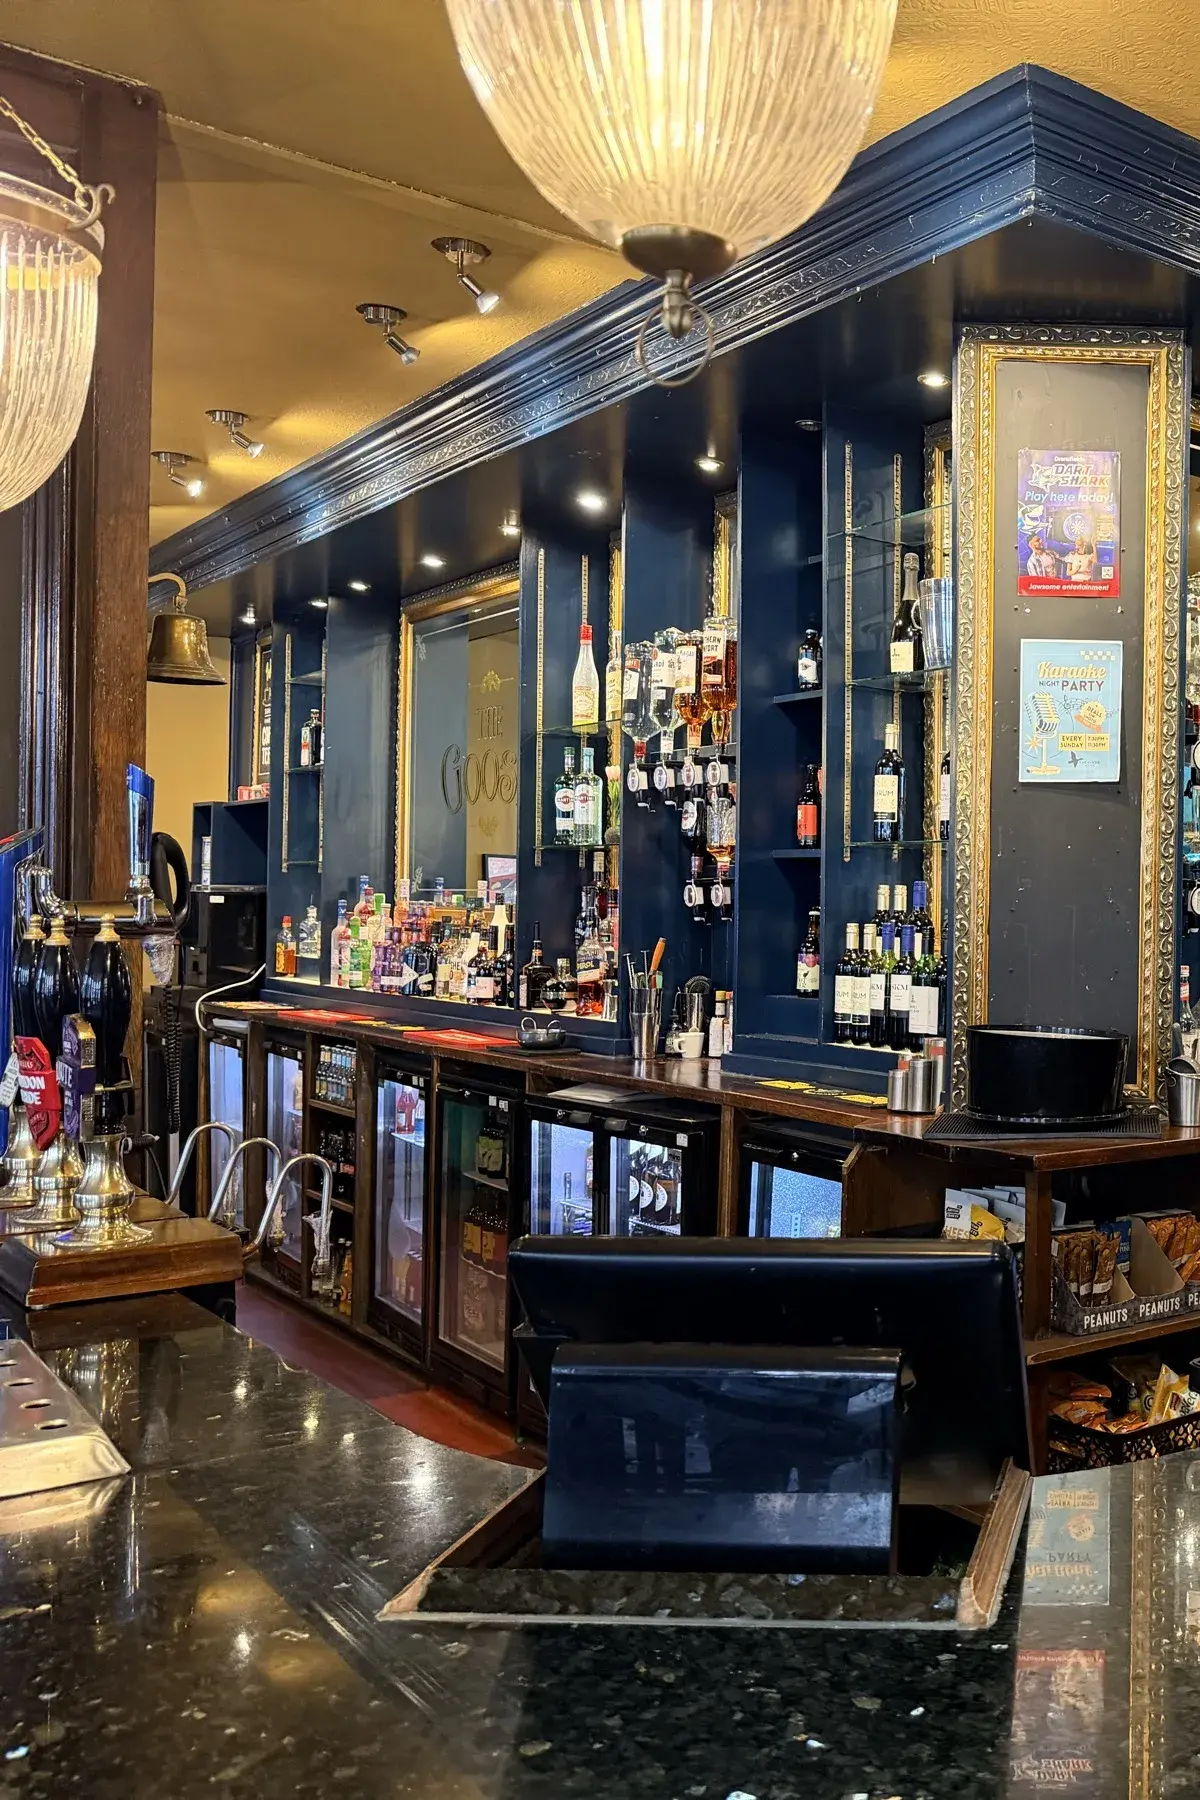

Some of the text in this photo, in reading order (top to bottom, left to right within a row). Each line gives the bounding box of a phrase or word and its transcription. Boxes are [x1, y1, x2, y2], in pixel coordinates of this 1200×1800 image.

[1054, 465, 1092, 475] DART
[1059, 475, 1108, 486] SHARK
[1025, 491, 1114, 502] Play here today!
[1038, 661, 1107, 679] Karaoke
[1061, 681, 1105, 692] PARTY
[475, 704, 504, 740] THE
[441, 743, 518, 815] GOOS
[1084, 1308, 1128, 1329] PEANUTS
[1139, 1297, 1180, 1317] PEANUTS
